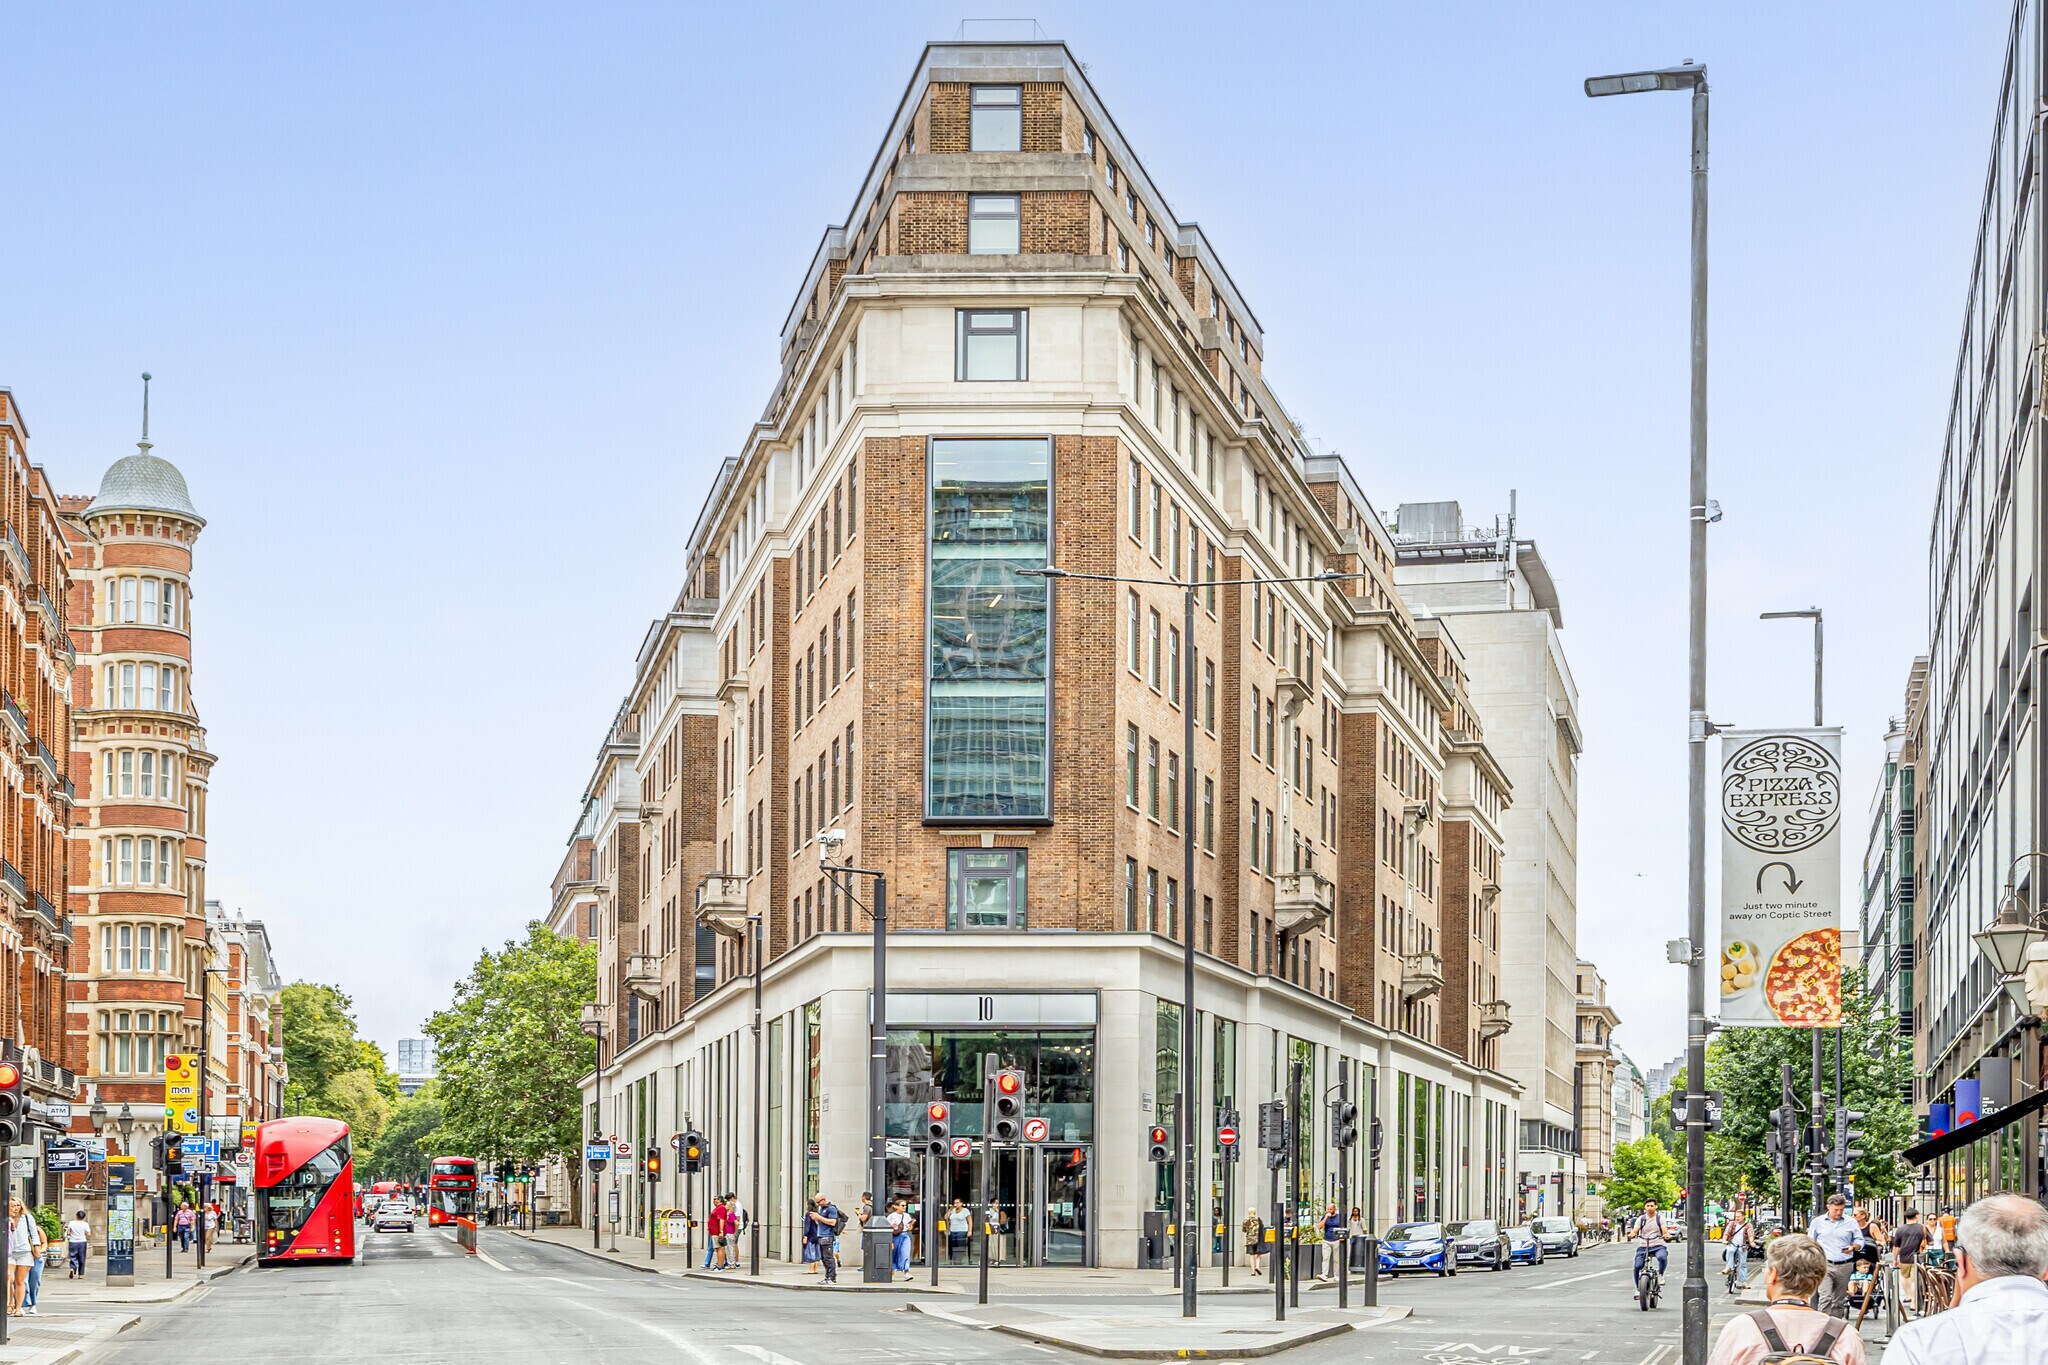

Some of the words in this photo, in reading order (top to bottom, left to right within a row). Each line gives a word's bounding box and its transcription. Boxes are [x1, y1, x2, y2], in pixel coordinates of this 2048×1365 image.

[1748, 777, 1813, 792] PIZZA
[1729, 791, 1832, 807] EXPRESS
[1743, 902, 1763, 910] Just
[1785, 901, 1818, 909] minute
[1729, 913, 1753, 921] away
[1755, 912, 1767, 920] on
[1769, 910, 1801, 920] Coptic
[1803, 910, 1832, 918] Street
[978, 996, 993, 1021] 10
[302, 1173, 314, 1184] 19
